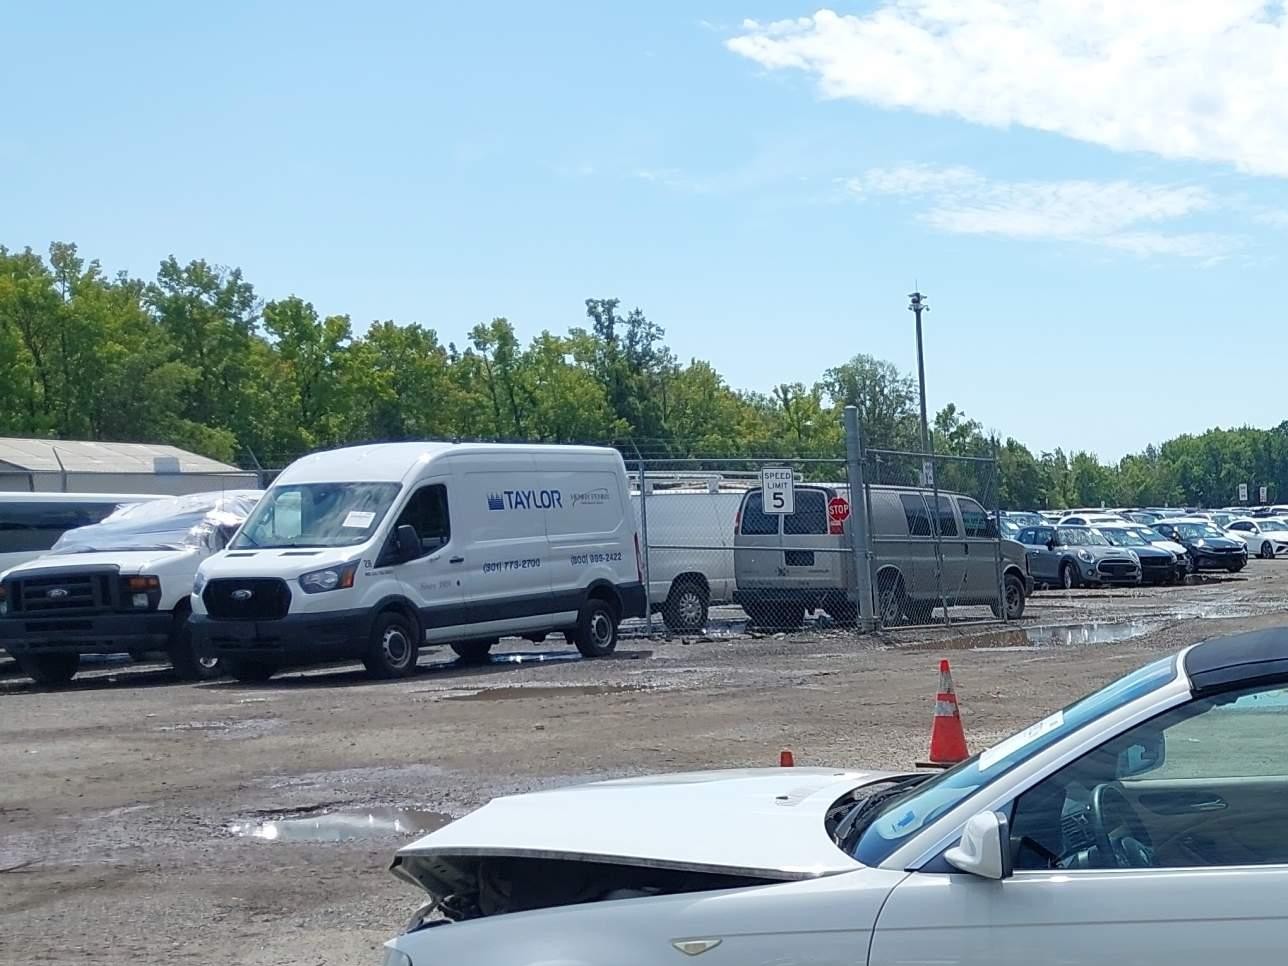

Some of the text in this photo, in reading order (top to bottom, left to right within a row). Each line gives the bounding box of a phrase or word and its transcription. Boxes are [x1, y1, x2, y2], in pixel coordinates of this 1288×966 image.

[504, 490, 563, 510] TAYLOR
[773, 492, 784, 508] 5
[829, 506, 849, 515] STOP
